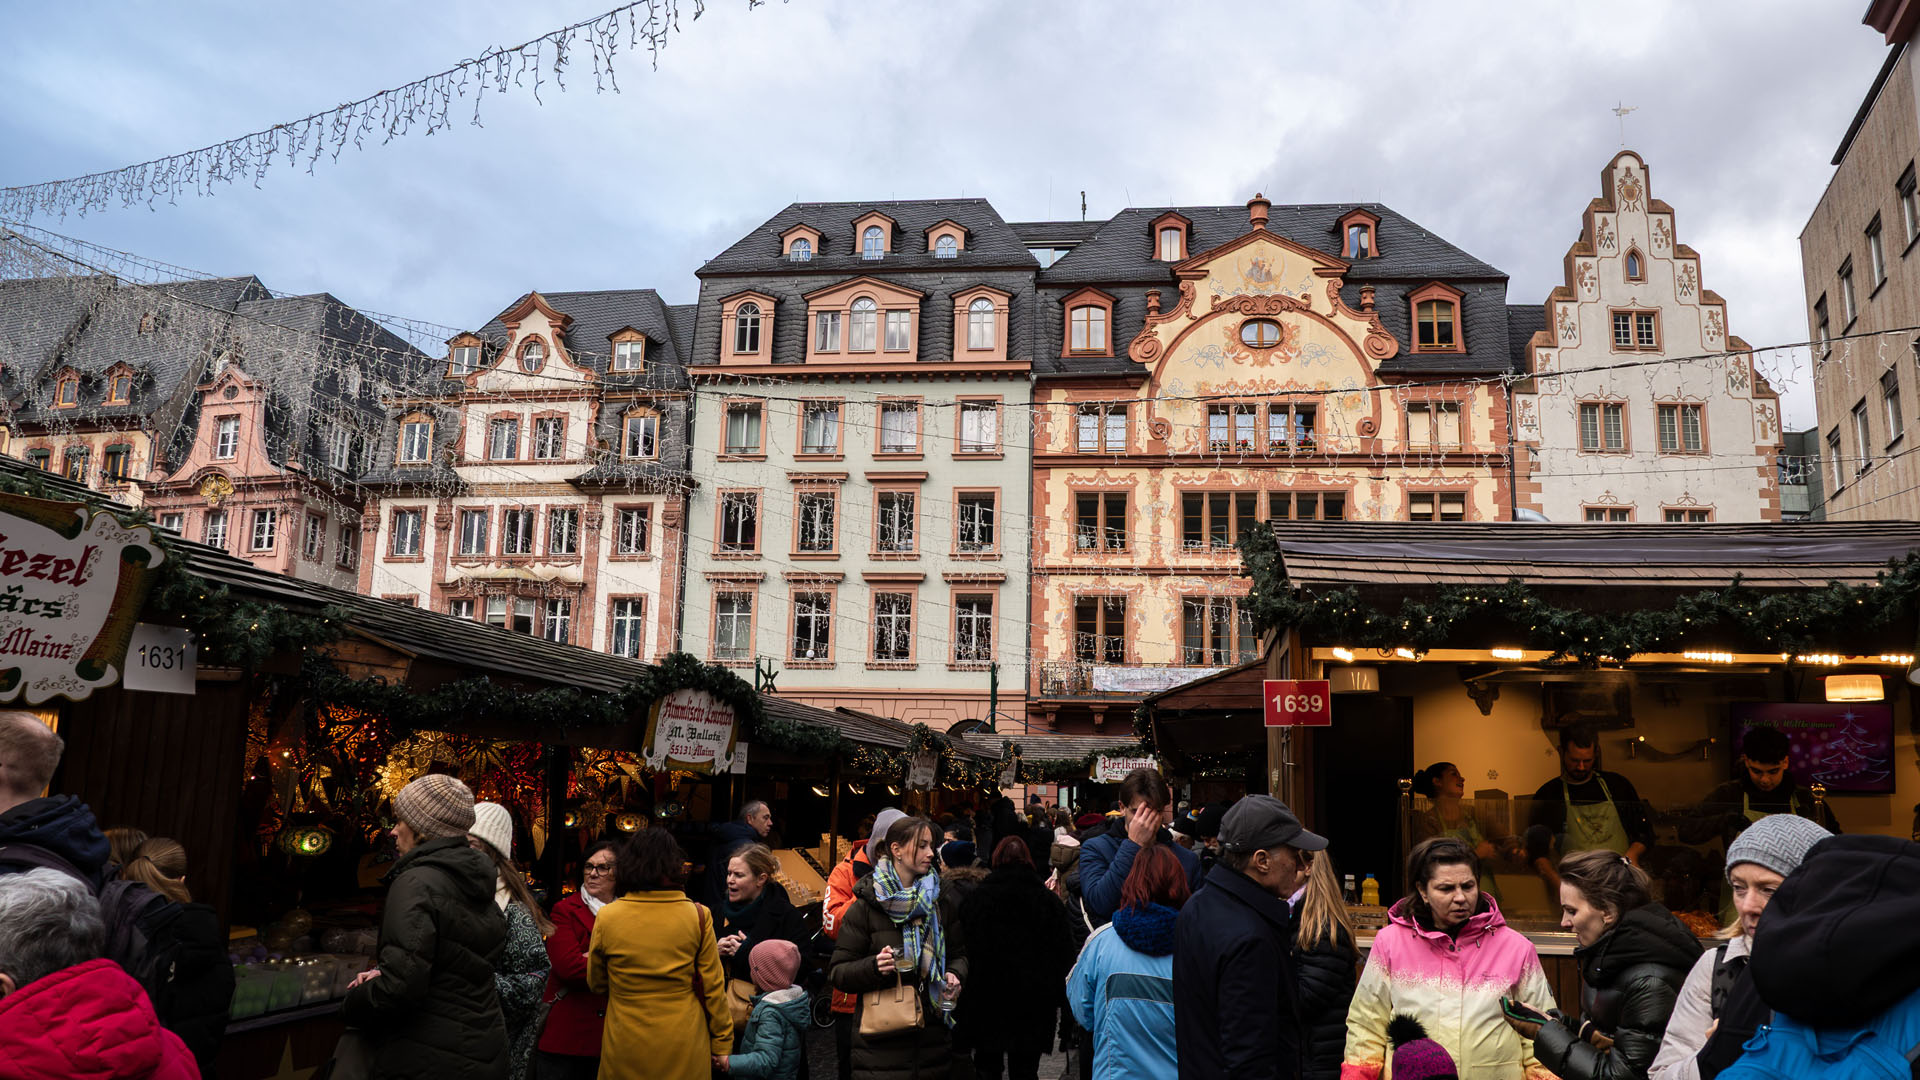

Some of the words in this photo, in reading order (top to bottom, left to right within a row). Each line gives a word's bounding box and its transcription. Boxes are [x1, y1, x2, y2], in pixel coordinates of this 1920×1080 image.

[0, 533, 98, 587] ezel
[0, 627, 74, 660] Mainz
[138, 644, 186, 671] 1631
[1272, 694, 1323, 713] 1639
[666, 727, 684, 742] M.
[670, 744, 692, 756] 55131
[1101, 756, 1154, 772] Perlkönig
